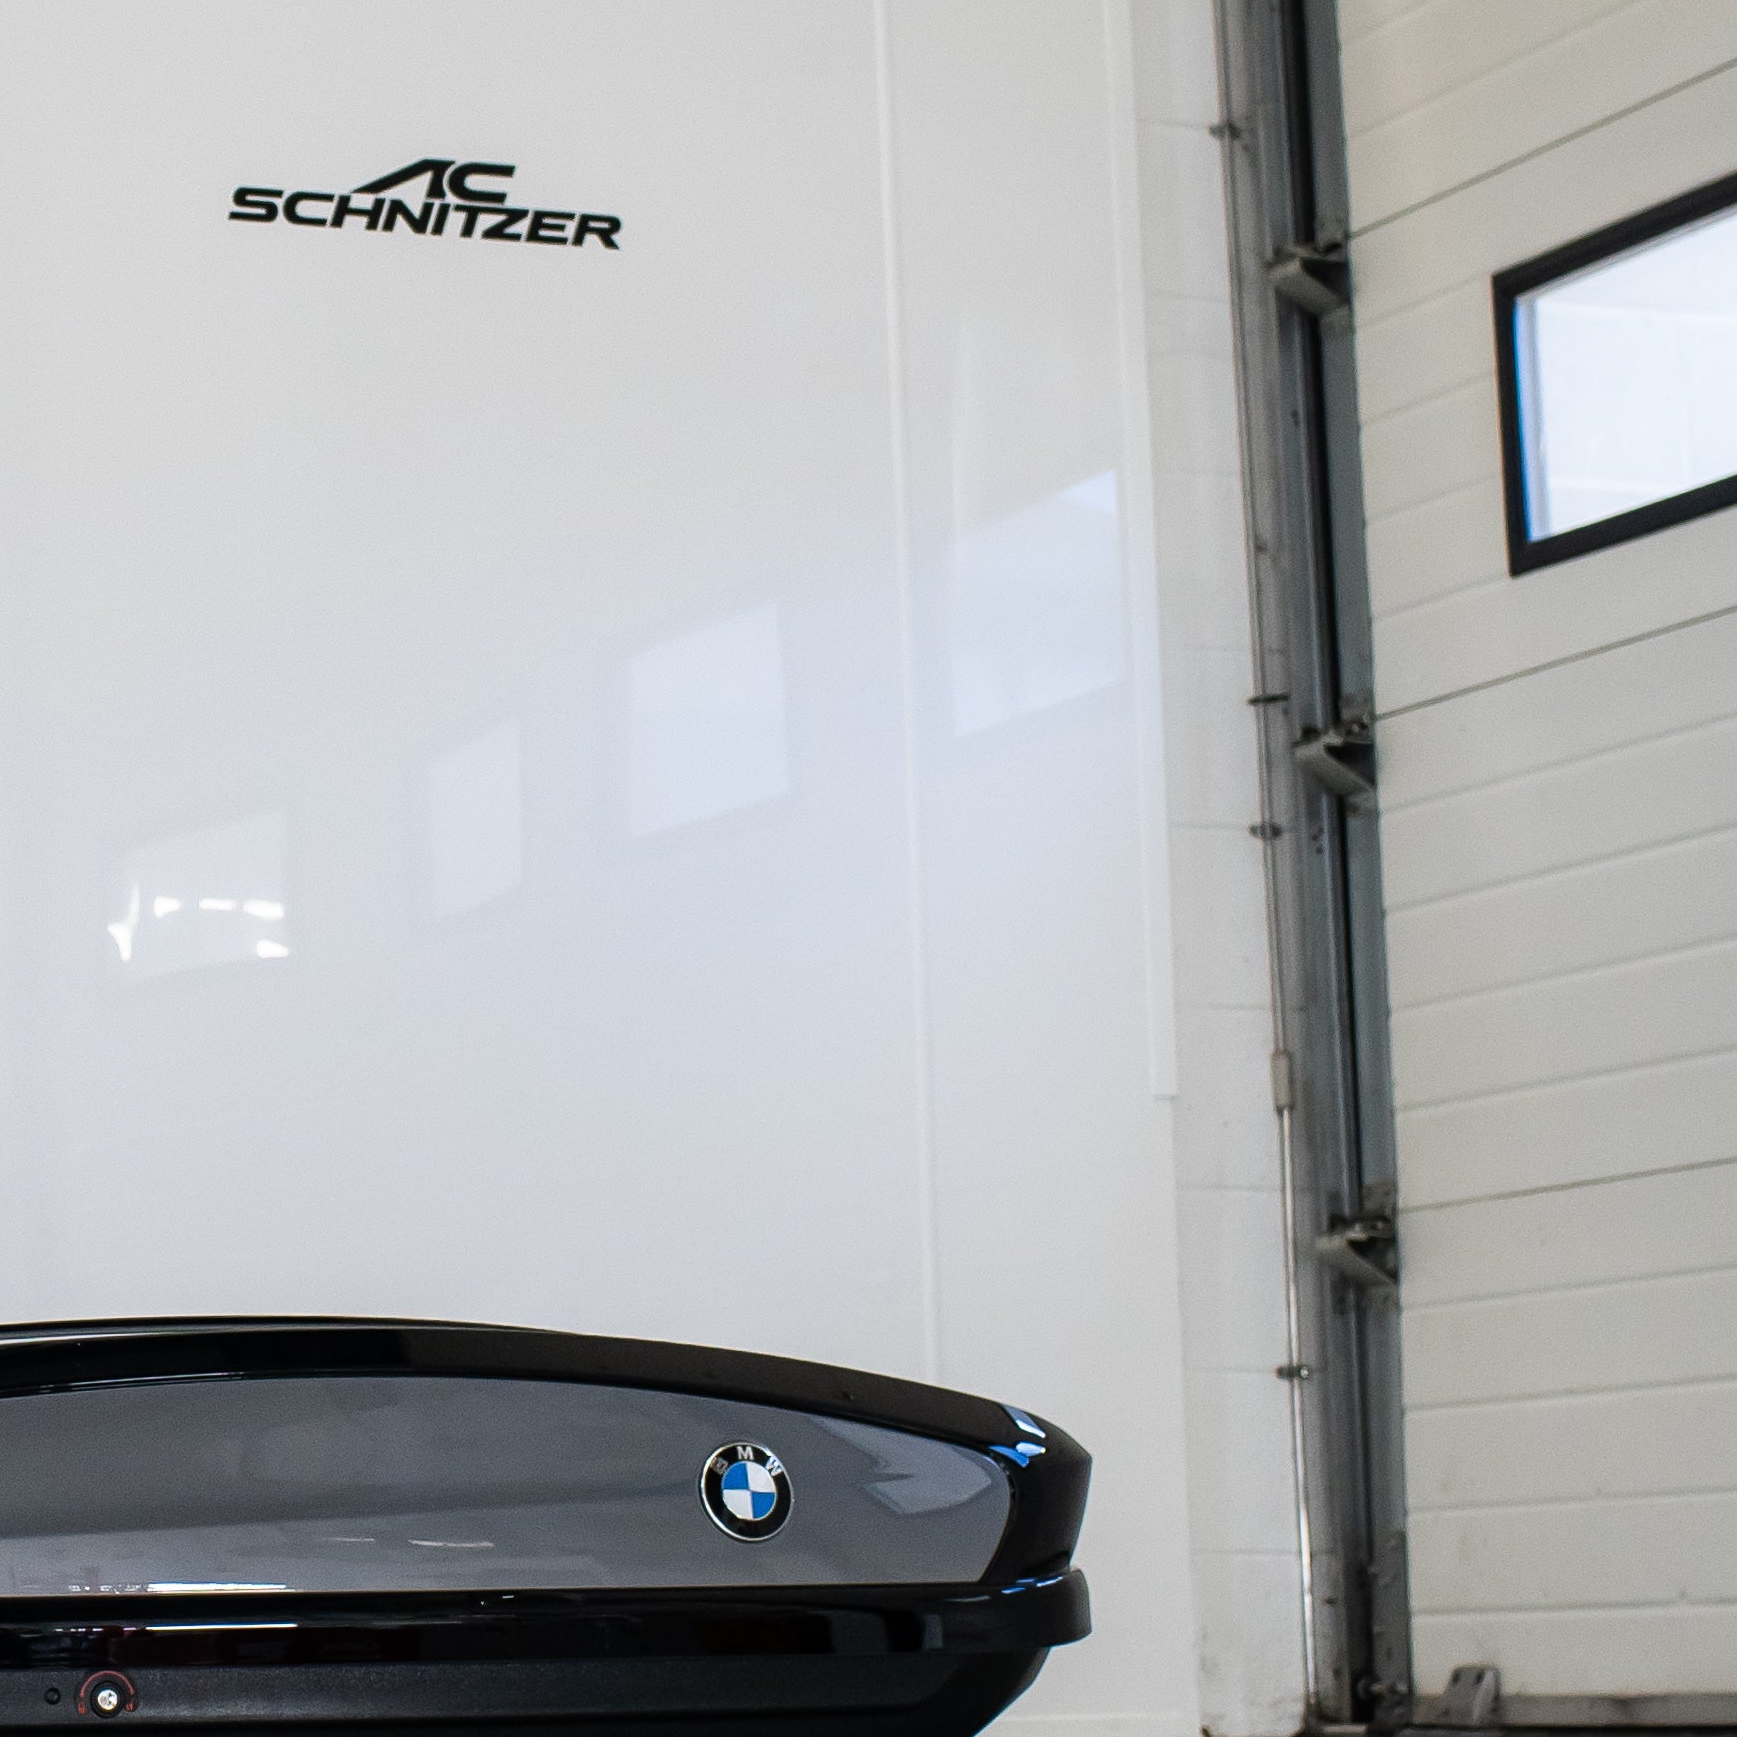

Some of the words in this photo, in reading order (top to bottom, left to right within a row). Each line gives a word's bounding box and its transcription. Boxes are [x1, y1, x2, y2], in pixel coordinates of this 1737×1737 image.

[349, 158, 516, 206] AC
[228, 186, 622, 250] SCHNITZER
[709, 1445, 783, 1477] BMW
